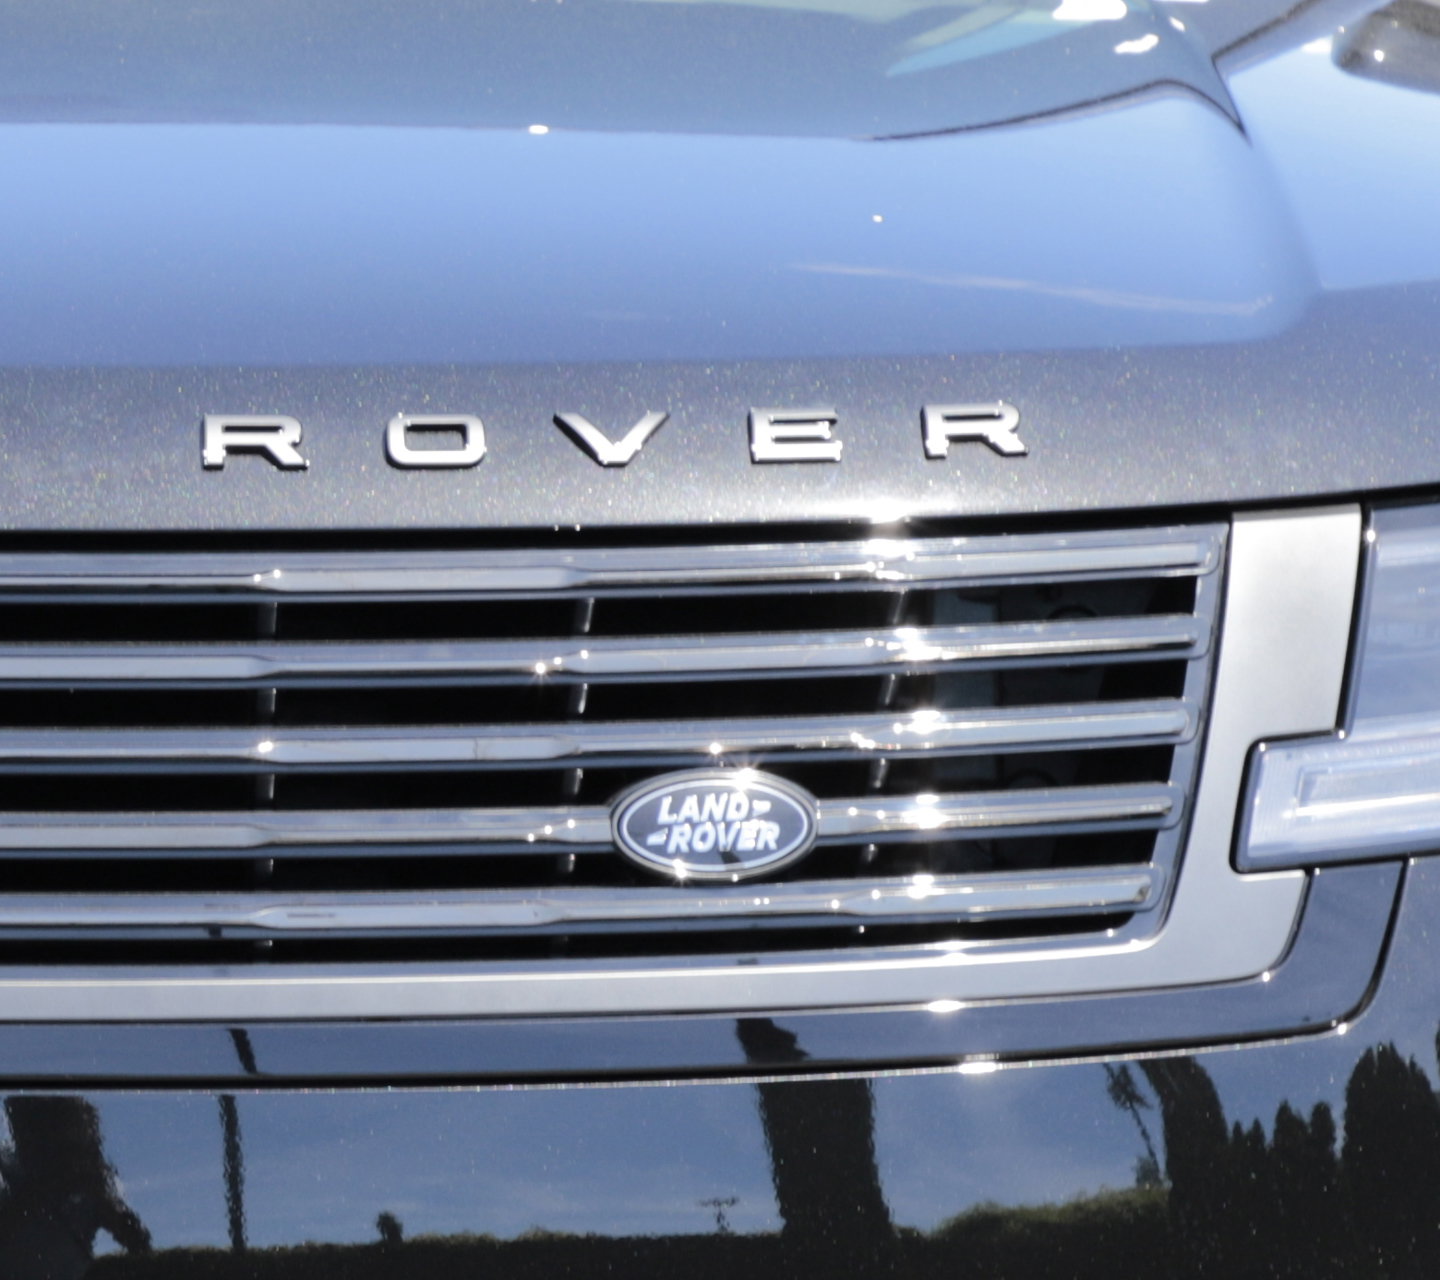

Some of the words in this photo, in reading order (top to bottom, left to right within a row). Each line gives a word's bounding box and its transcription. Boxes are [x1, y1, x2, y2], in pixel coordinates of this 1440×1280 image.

[201, 400, 1030, 469] ROVER
[657, 792, 750, 825] LAND
[666, 818, 781, 854] ROVER
